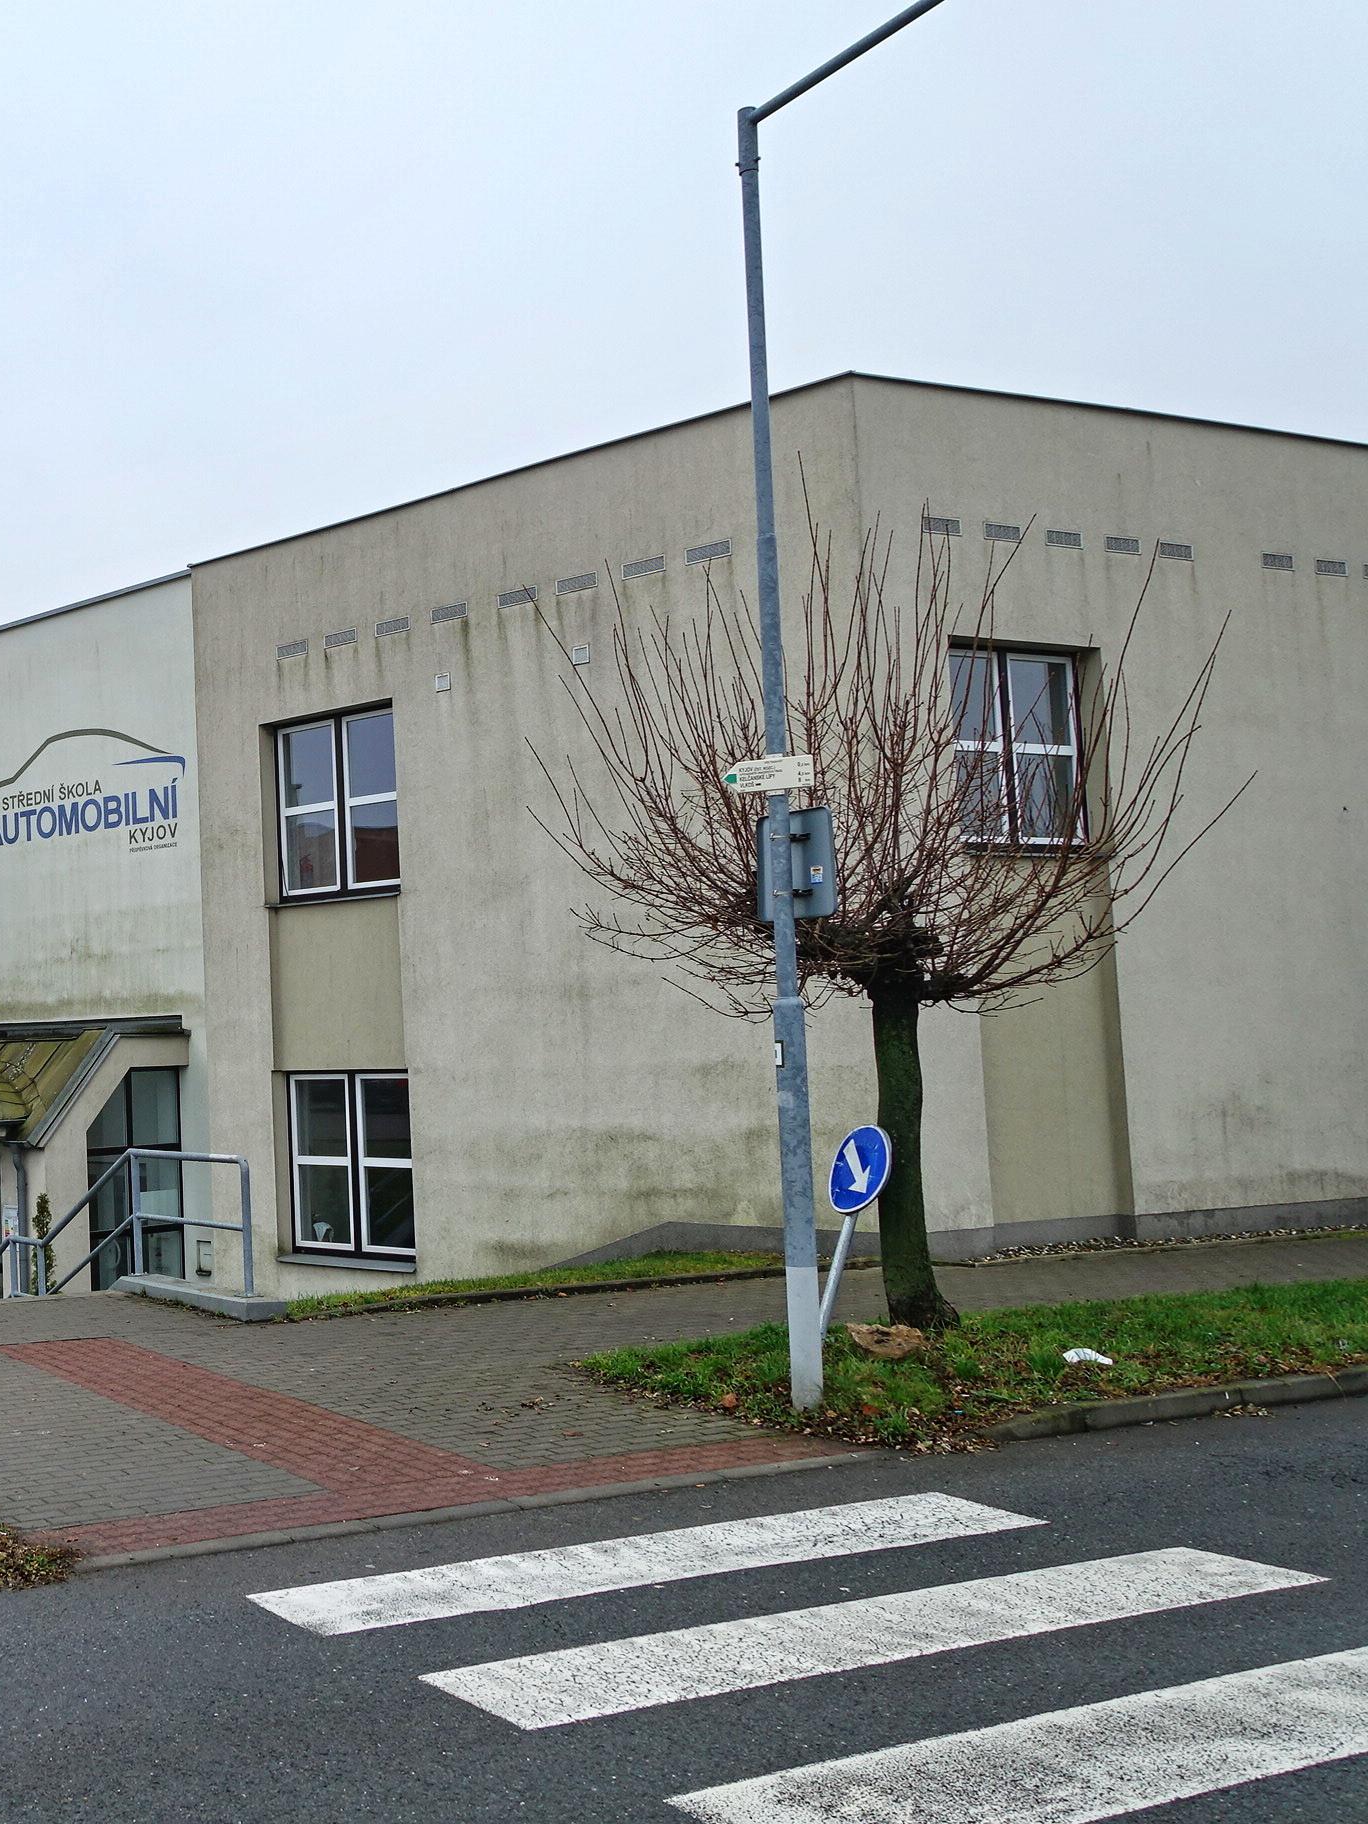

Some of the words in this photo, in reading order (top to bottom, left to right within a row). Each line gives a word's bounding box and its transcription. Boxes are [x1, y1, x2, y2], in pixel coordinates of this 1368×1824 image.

[2, 785, 54, 811] STŘEDNÍ
[58, 780, 102, 800] ŠKOLA
[129, 822, 178, 845] KYJOV
